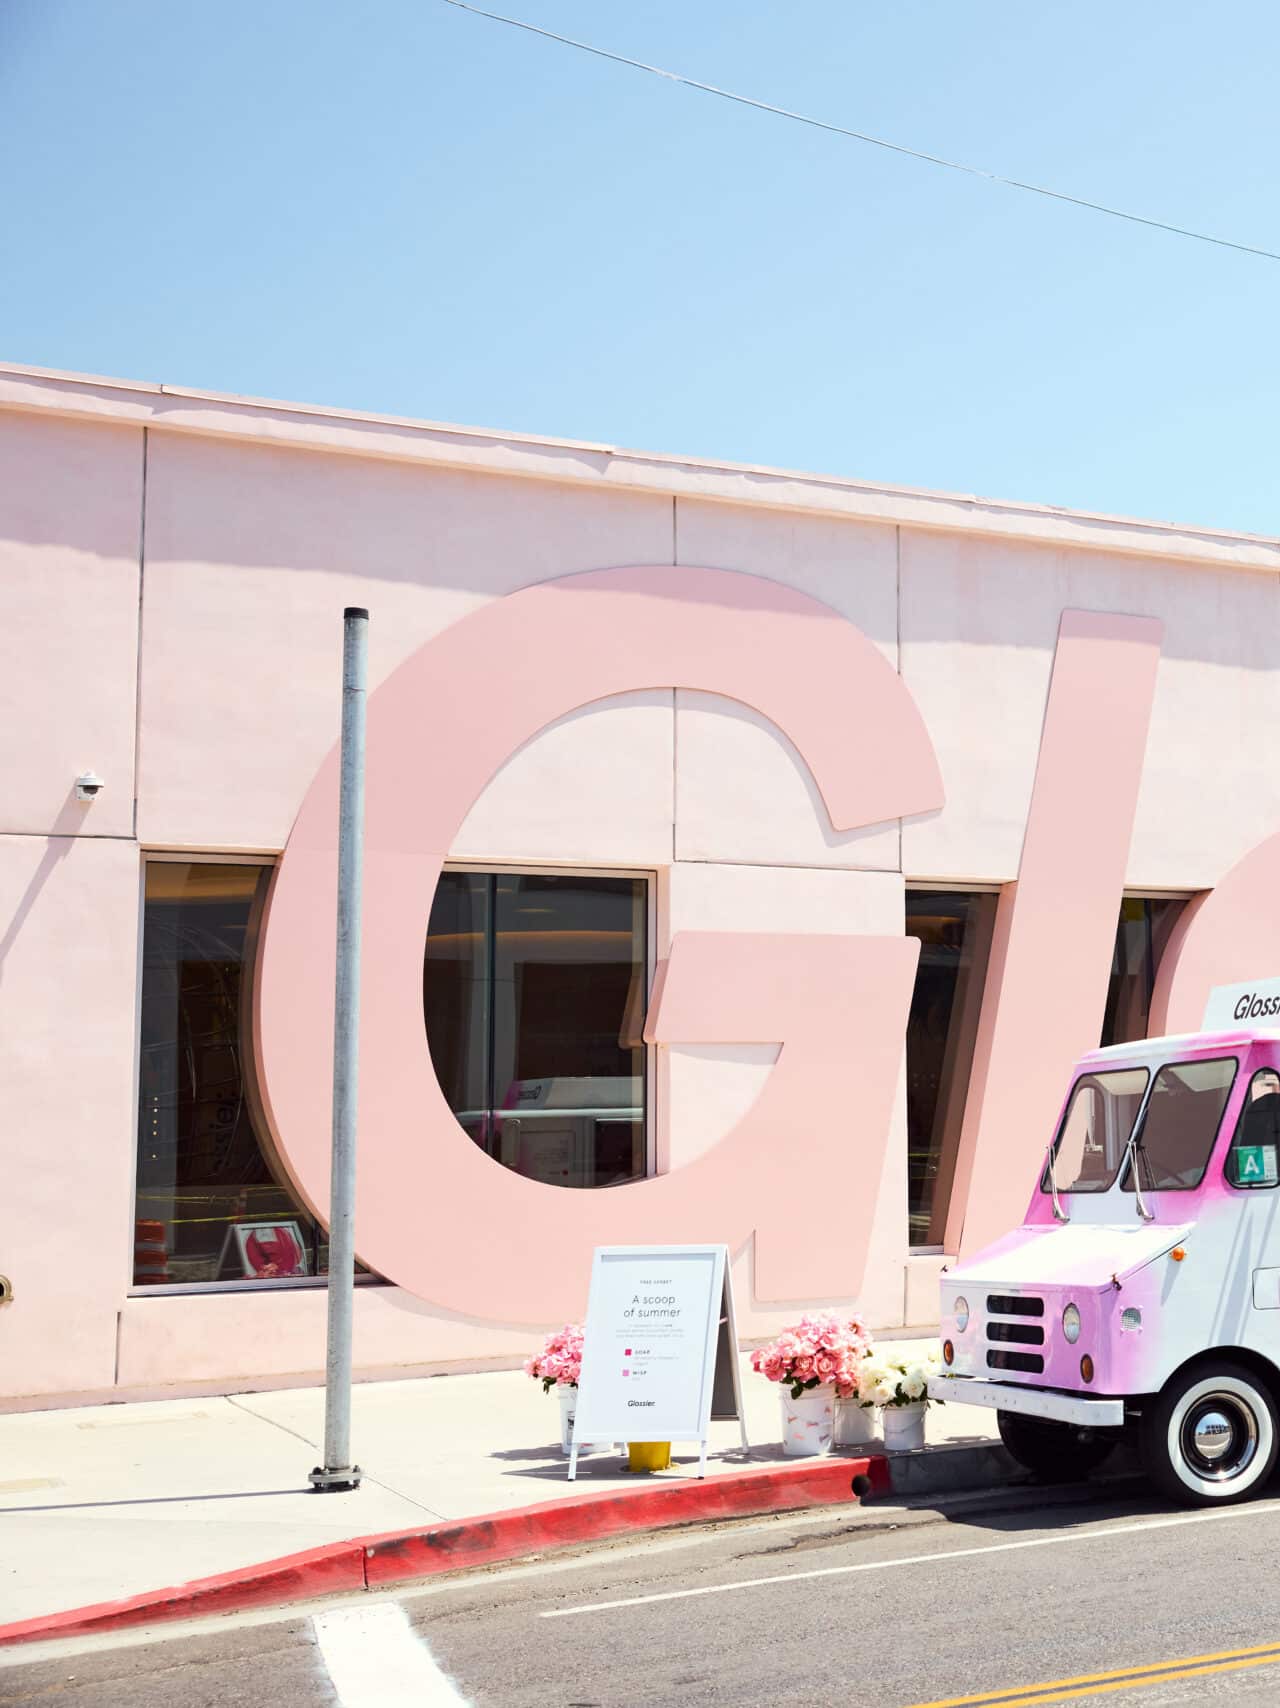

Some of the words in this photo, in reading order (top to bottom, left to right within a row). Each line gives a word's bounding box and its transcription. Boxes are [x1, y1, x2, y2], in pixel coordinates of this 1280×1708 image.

[1244, 1154, 1260, 1175] A
[632, 1295, 640, 1304] A
[643, 1295, 676, 1305] scoop
[623, 1308, 635, 1318] of
[638, 1308, 681, 1318] summer
